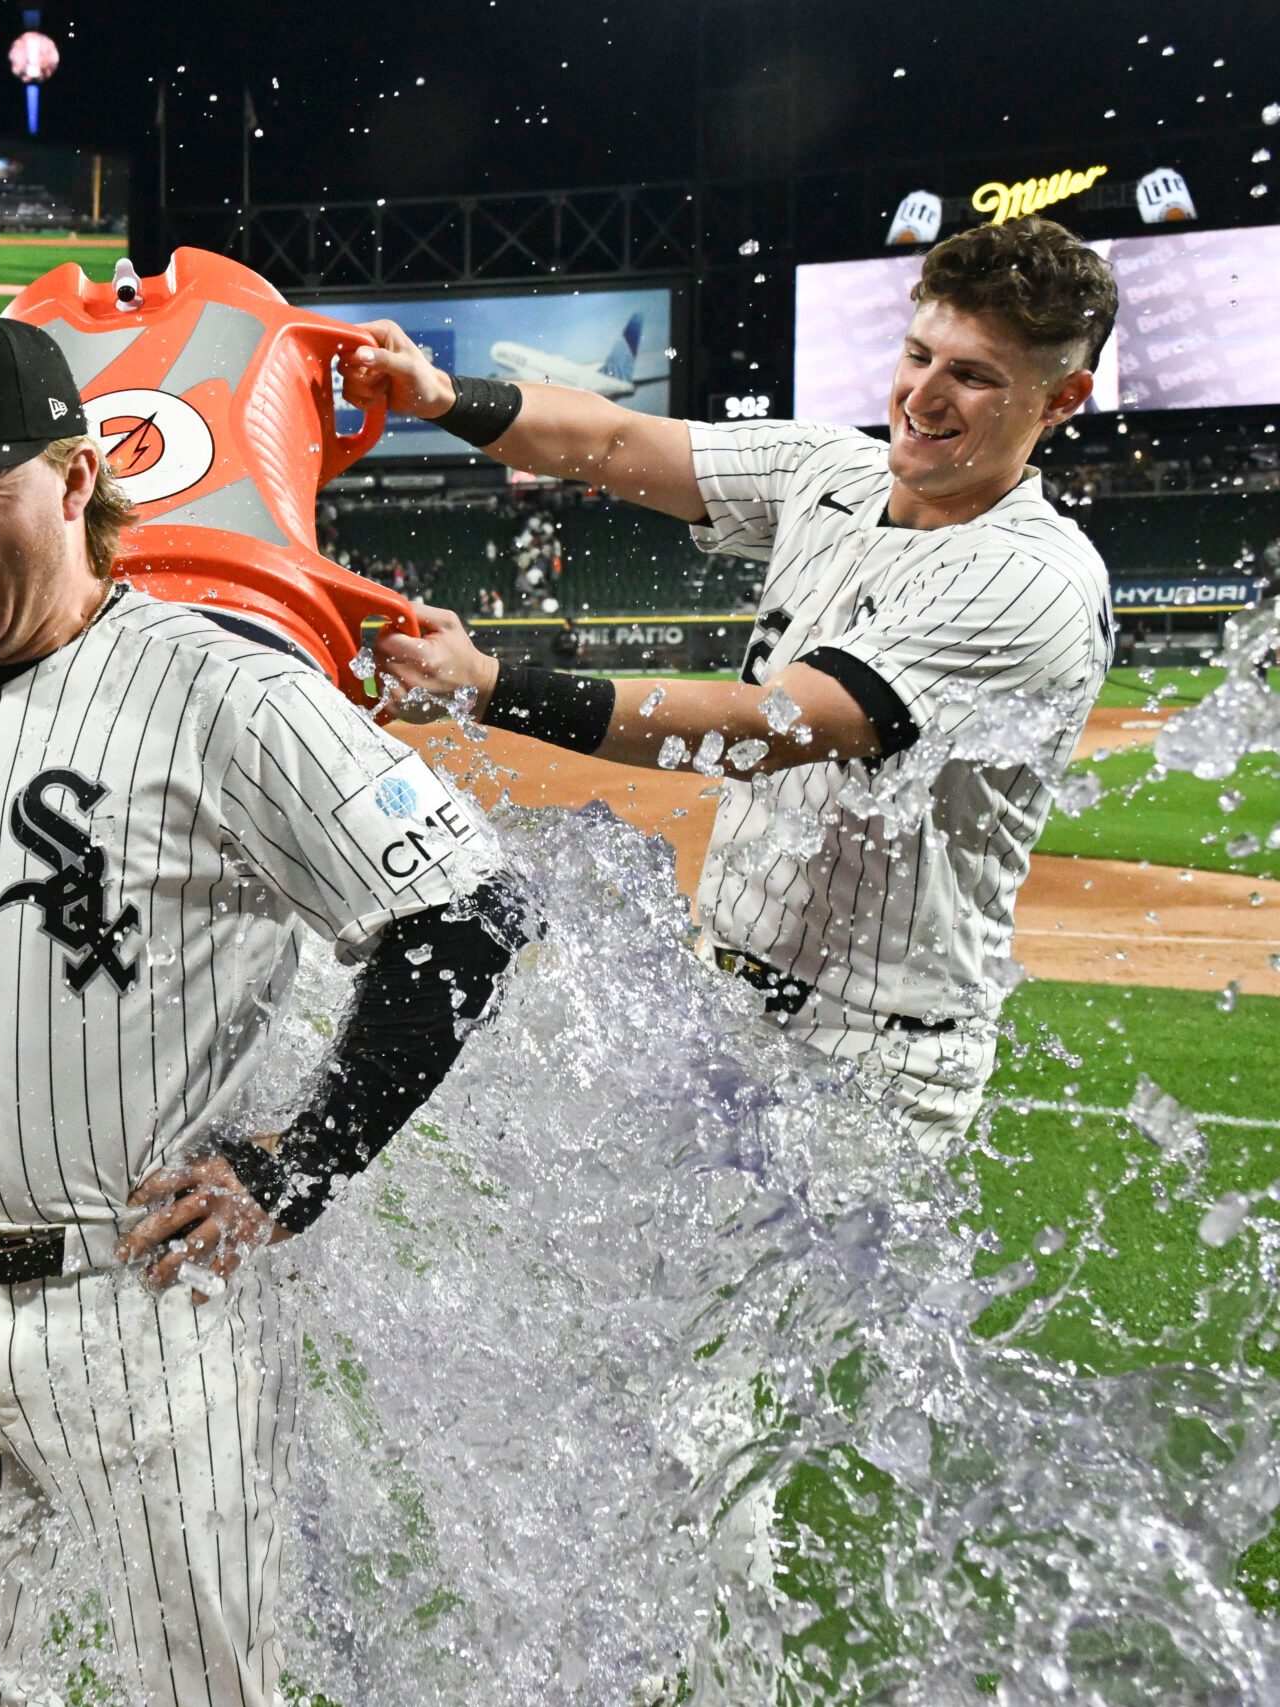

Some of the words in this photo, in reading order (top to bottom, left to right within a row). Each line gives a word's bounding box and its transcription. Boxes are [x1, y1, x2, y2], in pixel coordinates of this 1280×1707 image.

[972, 165, 1108, 226] Miller
[1143, 177, 1185, 207] Lite
[615, 626, 684, 646] PATIO
